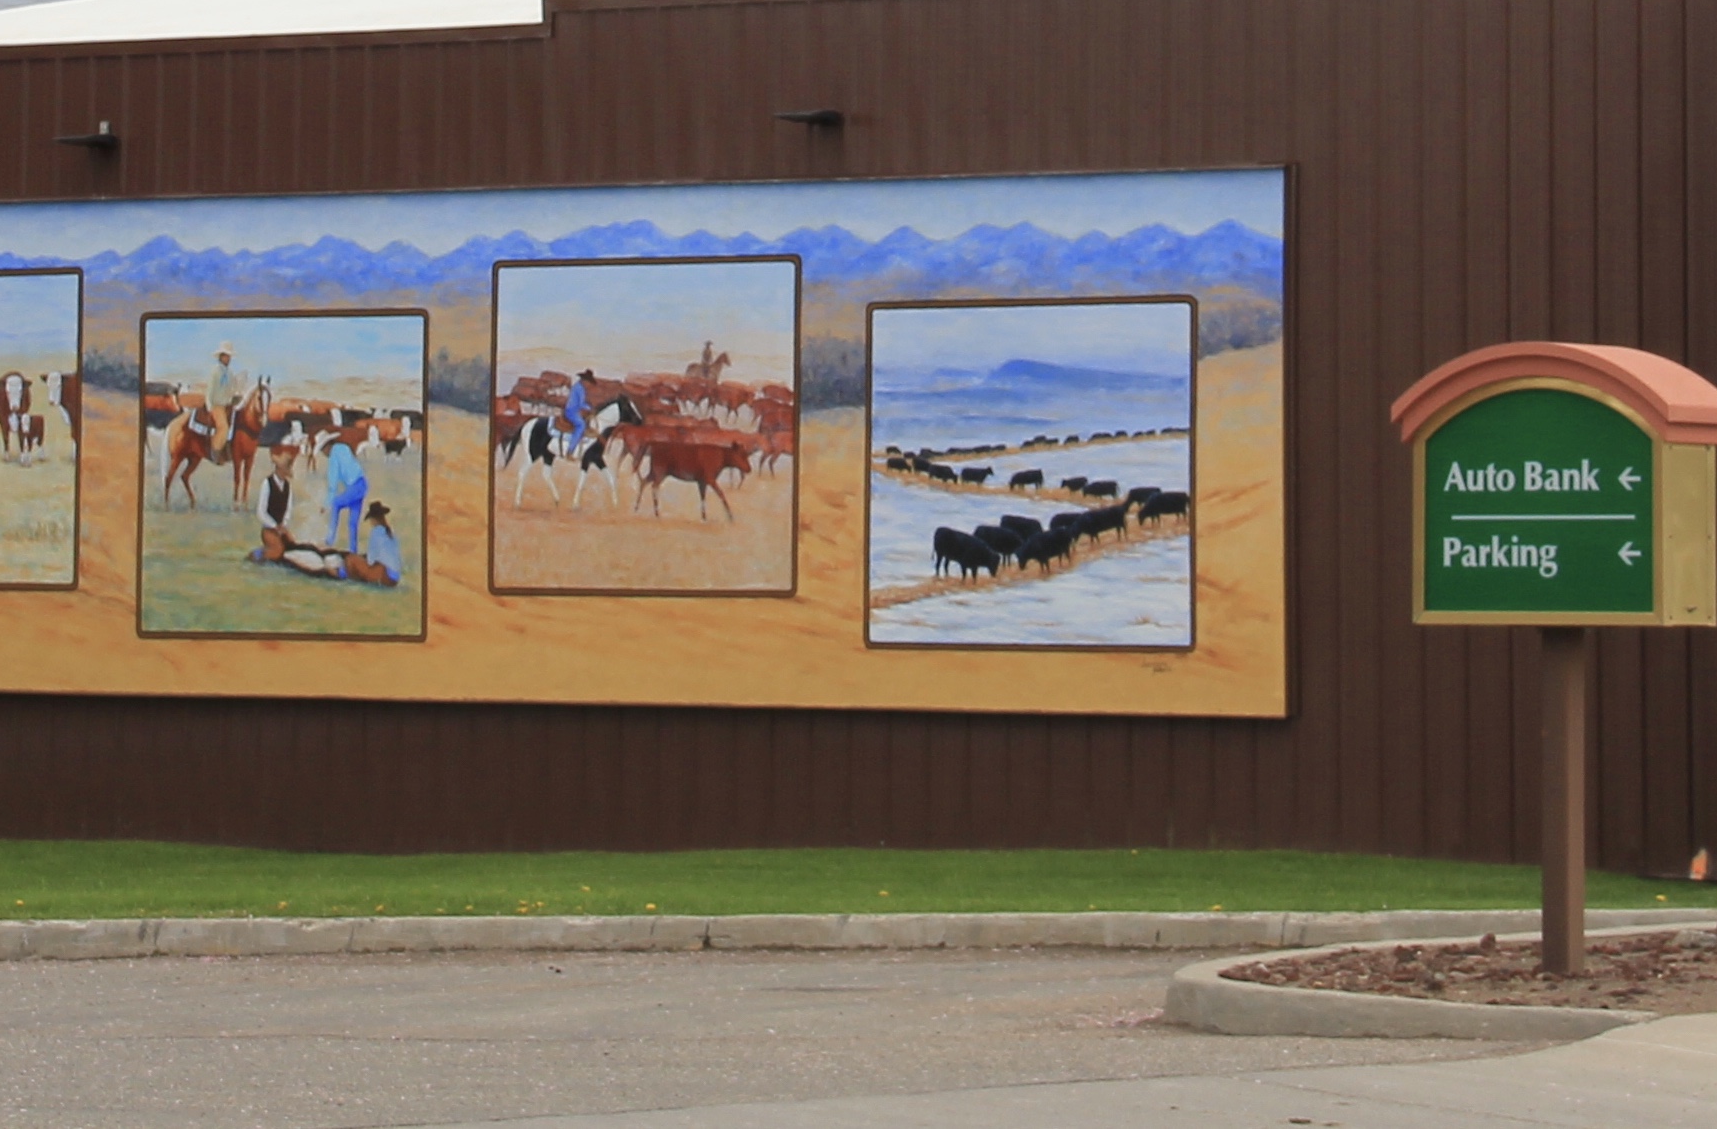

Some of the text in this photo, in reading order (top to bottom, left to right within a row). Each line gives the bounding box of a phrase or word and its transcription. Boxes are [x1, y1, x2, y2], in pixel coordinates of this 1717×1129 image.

[1443, 458, 1600, 492] Auto Bank
[1442, 535, 1558, 578] Parking
